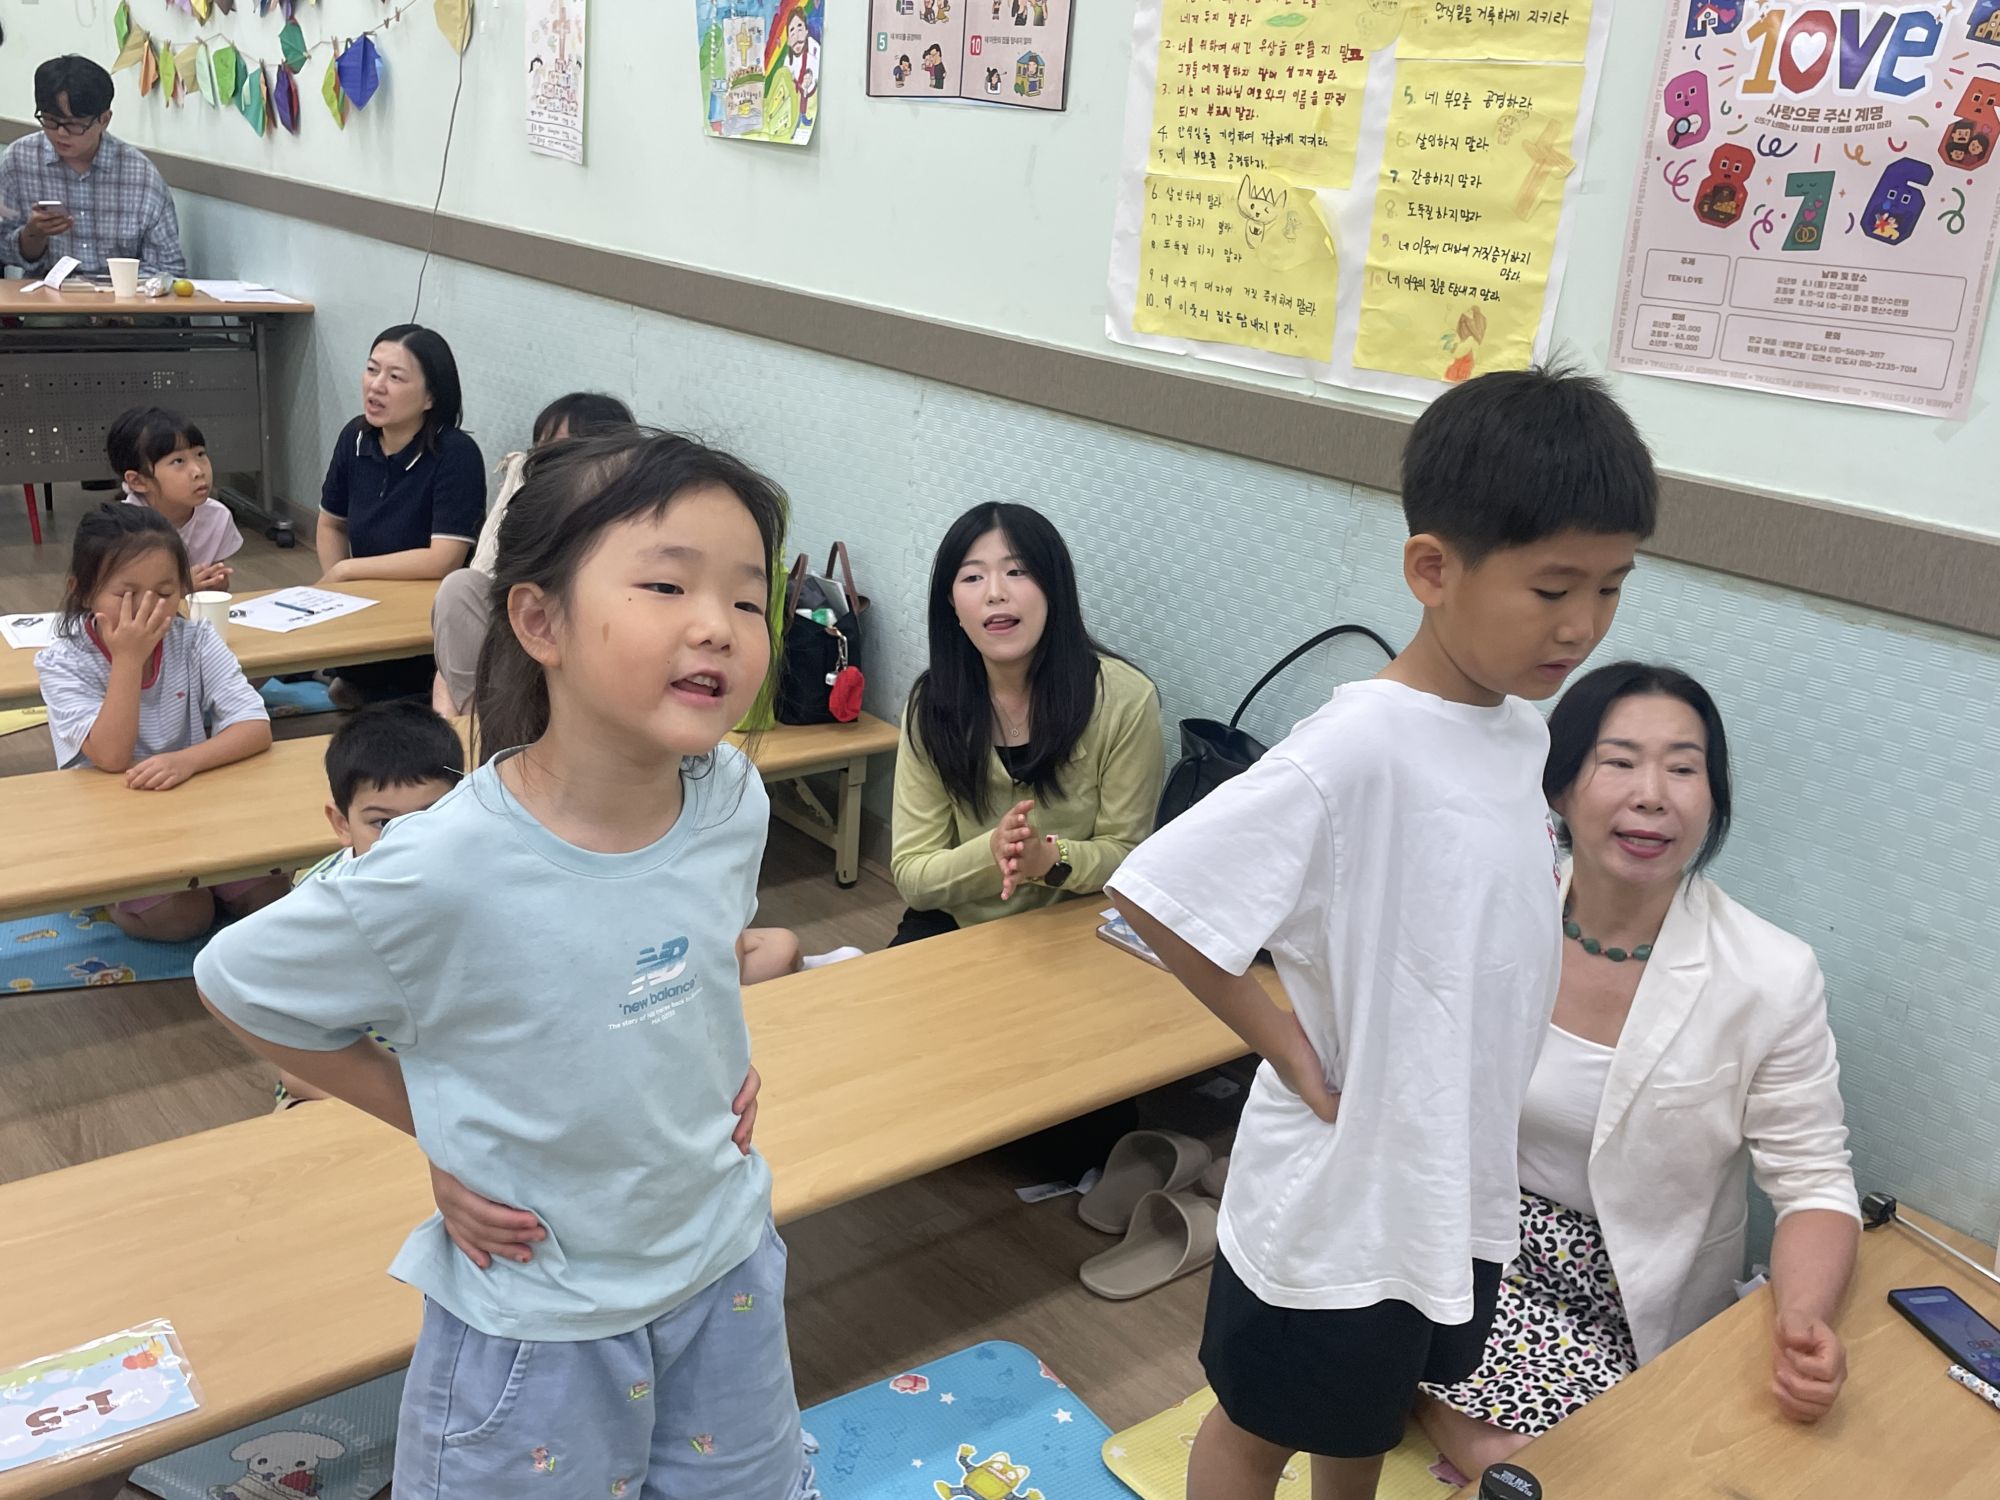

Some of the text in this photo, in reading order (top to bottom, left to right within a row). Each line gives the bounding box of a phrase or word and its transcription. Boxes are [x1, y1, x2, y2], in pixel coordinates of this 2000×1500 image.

[1258, 38, 1287, 57] 우상을
[1424, 91, 1438, 106] 네
[1444, 89, 1472, 110] 부모를
[1766, 103, 1884, 123] 사랑으로 주신 계명
[1816, 125, 1830, 134] 다른
[1415, 132, 1459, 151] 살인하지
[1667, 274, 1704, 285] TEN LOVE
[1851, 272, 1868, 283] 장소
